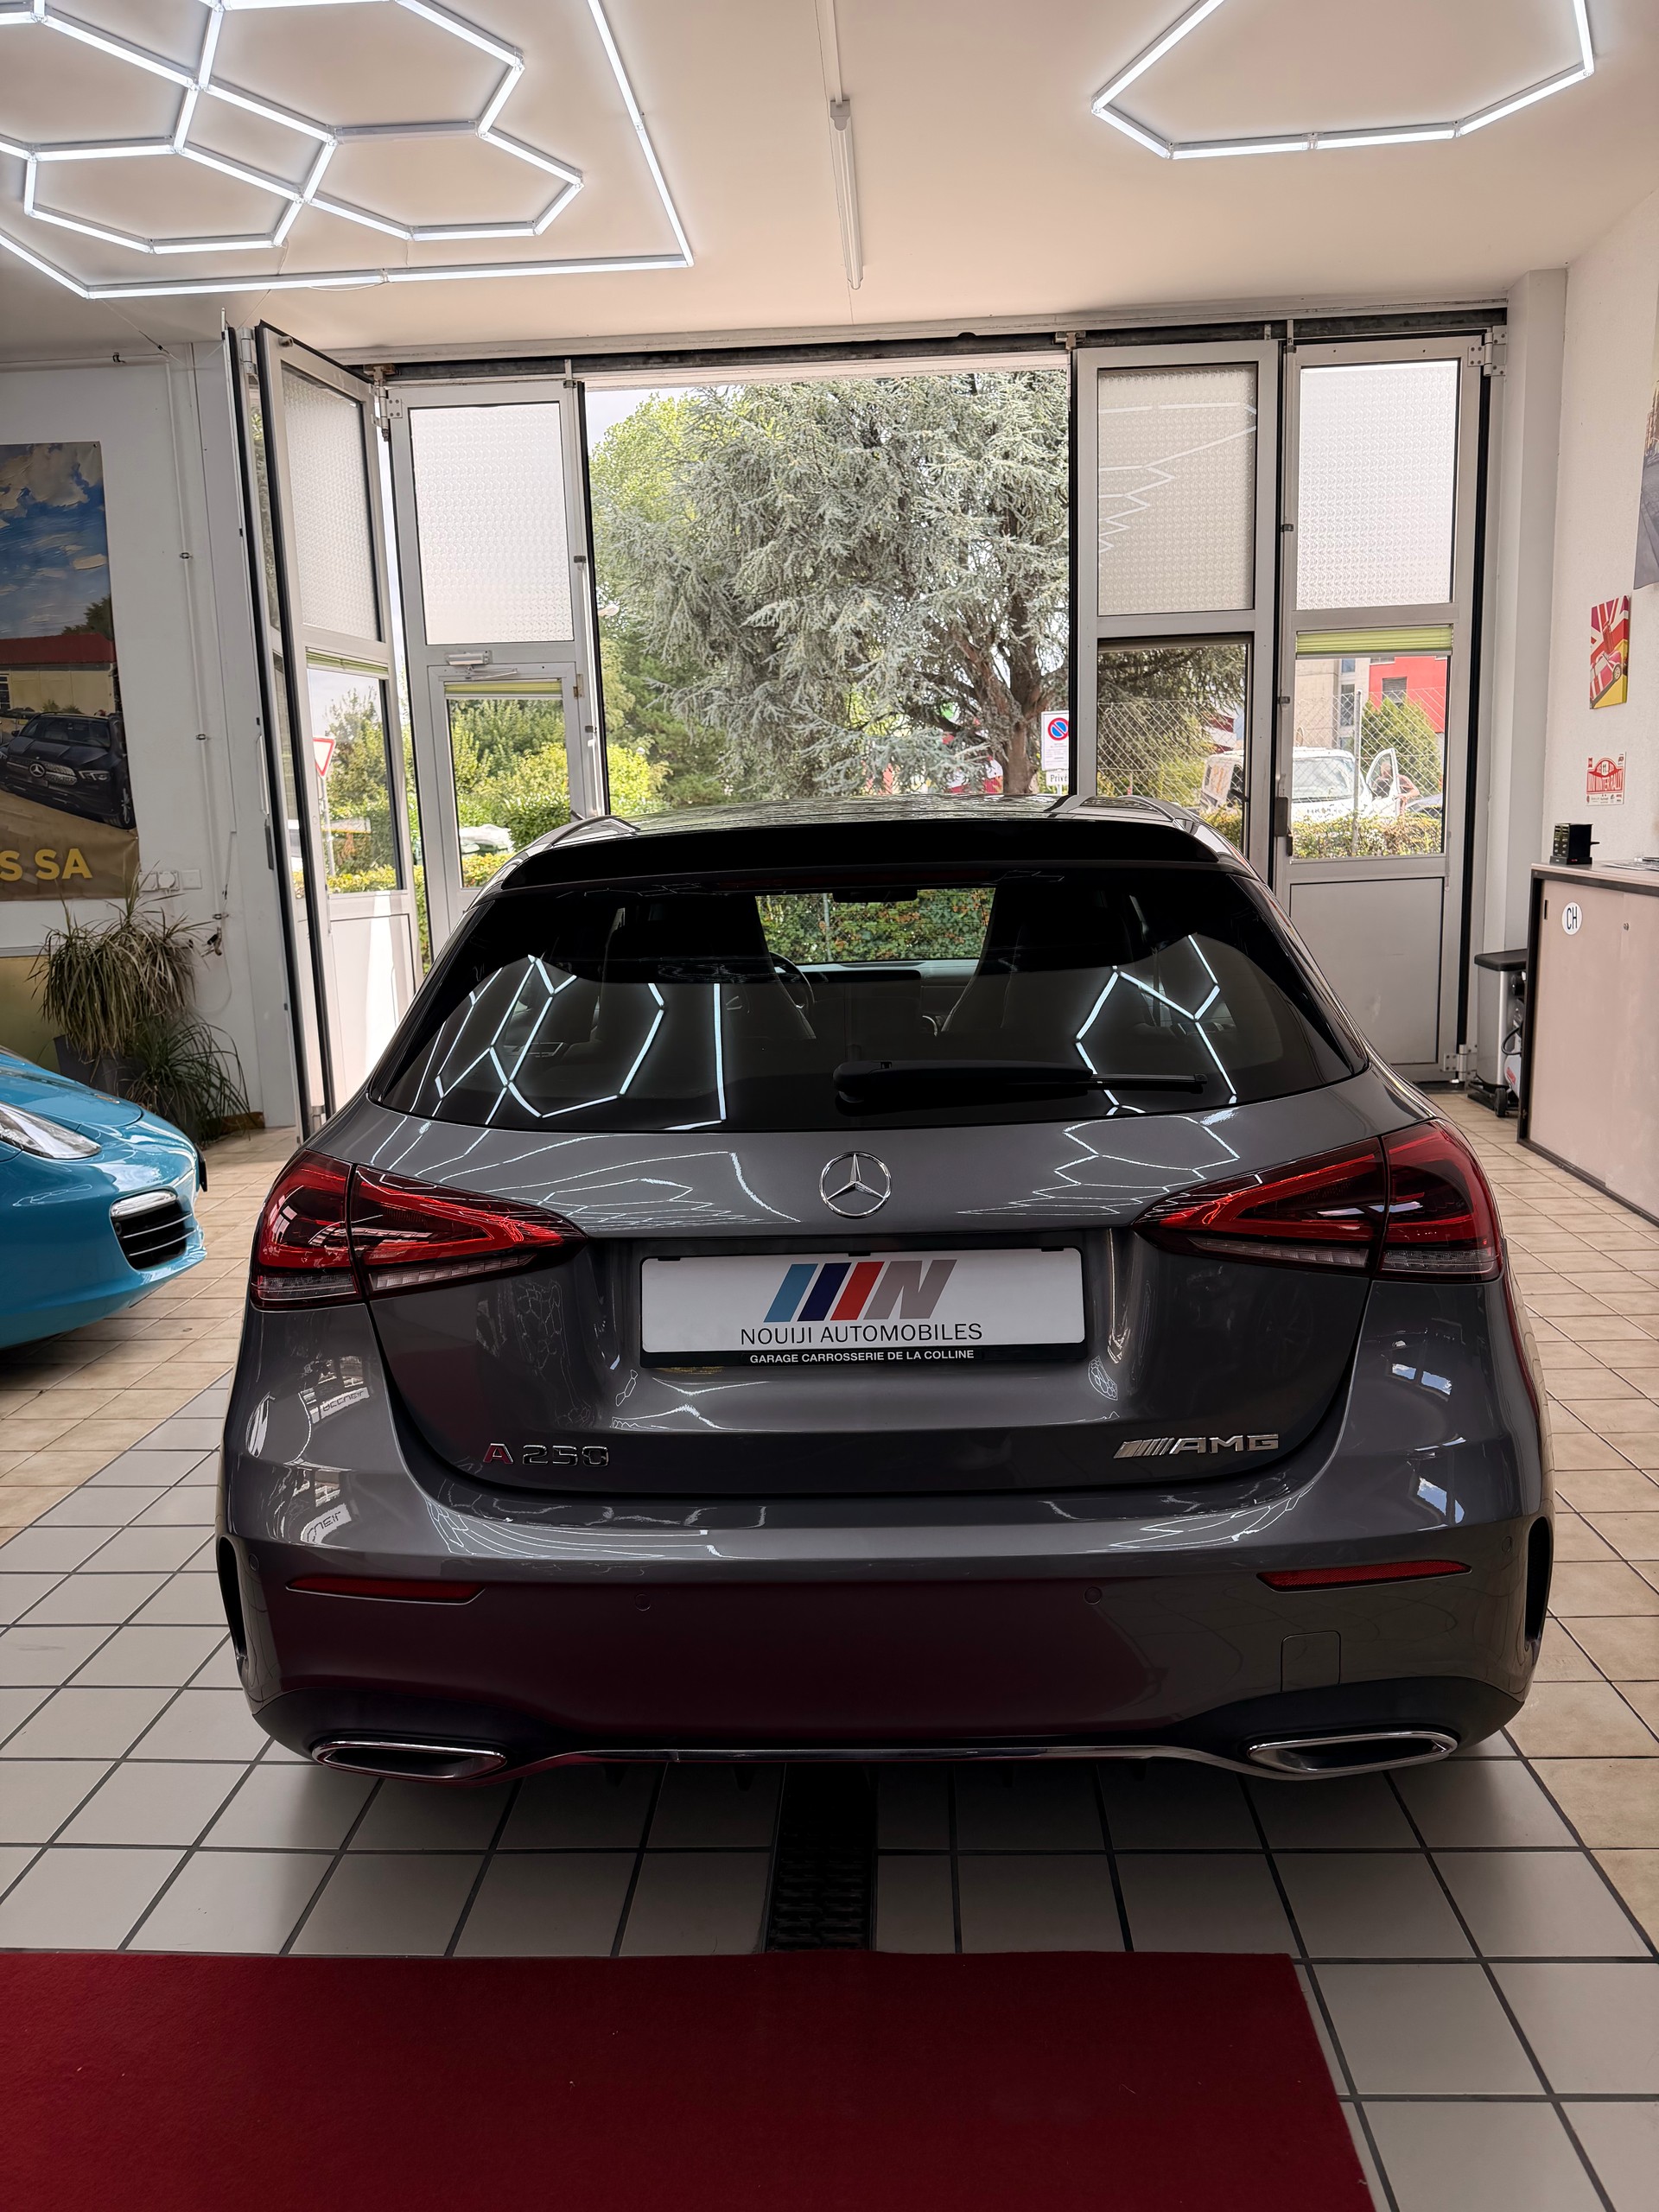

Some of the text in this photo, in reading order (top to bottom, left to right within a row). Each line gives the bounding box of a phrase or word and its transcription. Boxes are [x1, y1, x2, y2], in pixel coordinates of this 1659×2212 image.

[35, 848, 93, 880] SA
[1567, 906, 1578, 930] CH
[741, 1323, 982, 1345] NOUIJI AUTOMOBILES
[749, 1350, 975, 1363] GARAGE CARROSSERIE DE LA COLLINE
[483, 1443, 609, 1466] A 250
[1169, 1434, 1279, 1455] AMG
